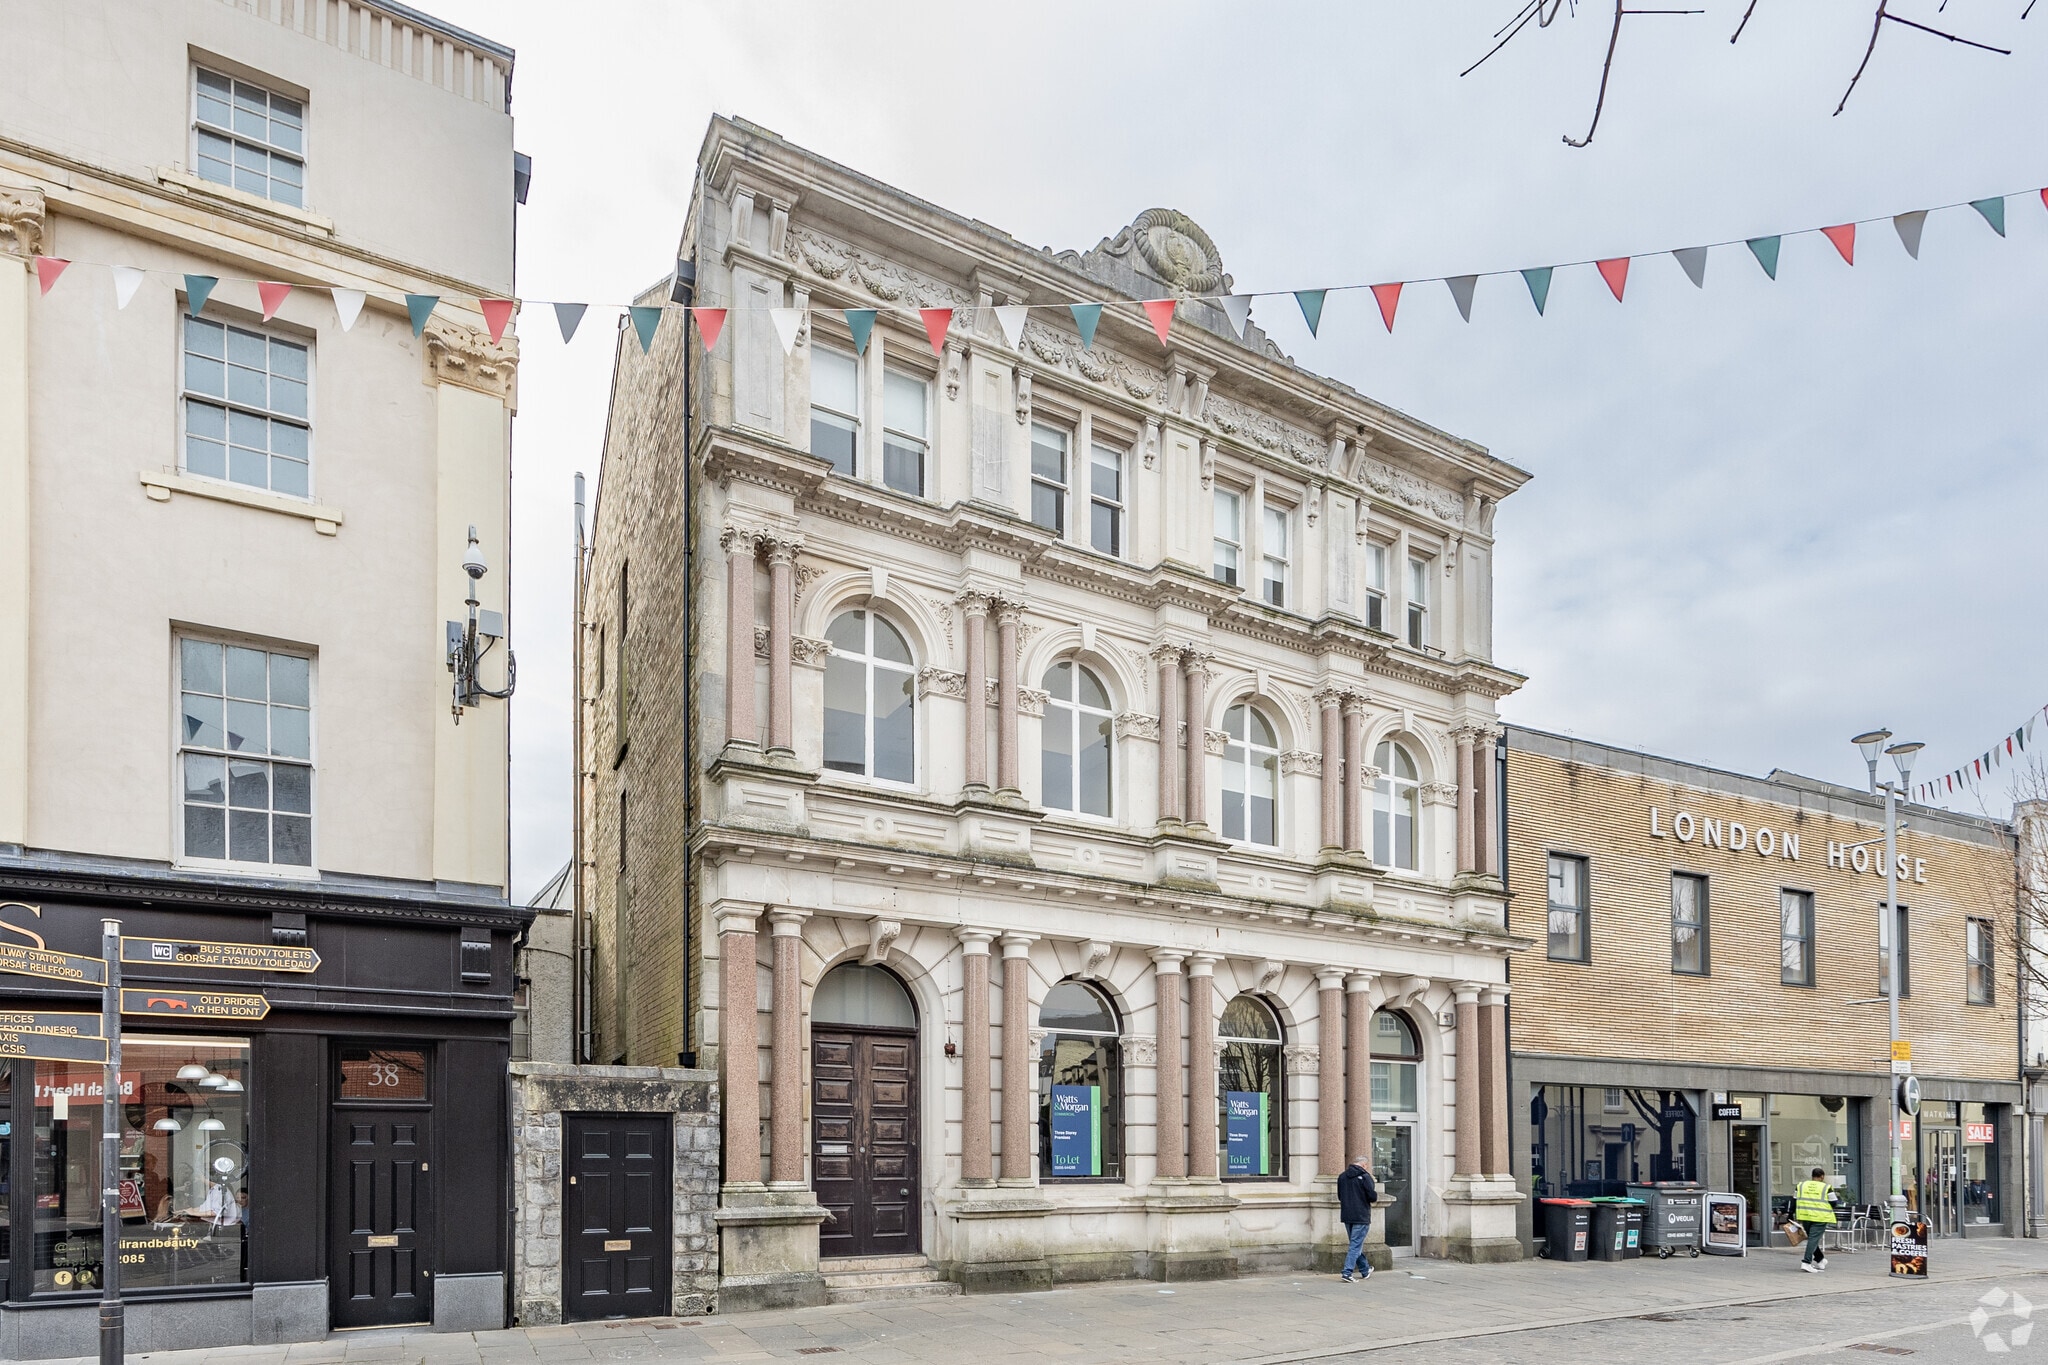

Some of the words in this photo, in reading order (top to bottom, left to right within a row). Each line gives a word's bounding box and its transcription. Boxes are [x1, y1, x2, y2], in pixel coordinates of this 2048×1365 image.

[1651, 806, 1800, 861] LONDON
[1828, 840, 1928, 883] HOUSE
[155, 946, 170, 956] WC
[200, 945, 222, 954] BUS
[224, 946, 311, 959] STATION/TOILETS
[29, 952, 66, 965] STATION
[176, 953, 219, 963] GORSAF
[222, 956, 311, 968] FYSIAU/TOILEDAU
[30, 963, 83, 978] REILFFORDD
[200, 996, 221, 1004] OLD
[223, 997, 260, 1006] BRIDGE
[191, 1005, 205, 1013] YR
[207, 1006, 229, 1014] HEN
[231, 1007, 260, 1016] BONT
[35, 1025, 78, 1034] DINESIG
[368, 1063, 399, 1087] 38
[1056, 1094, 1079, 1104] Watts
[1230, 1099, 1250, 1108] Watts
[1054, 1101, 1089, 1113] &Morgan
[1718, 1107, 1740, 1116] COFFEE
[1922, 1110, 1957, 1119] WATKINS
[1967, 1125, 1993, 1140] SALE
[1054, 1154, 1066, 1165] To
[1067, 1154, 1080, 1165] Let
[1229, 1154, 1239, 1164] To
[1240, 1154, 1251, 1164] Let
[1892, 1243, 1927, 1251] PASTRIES
